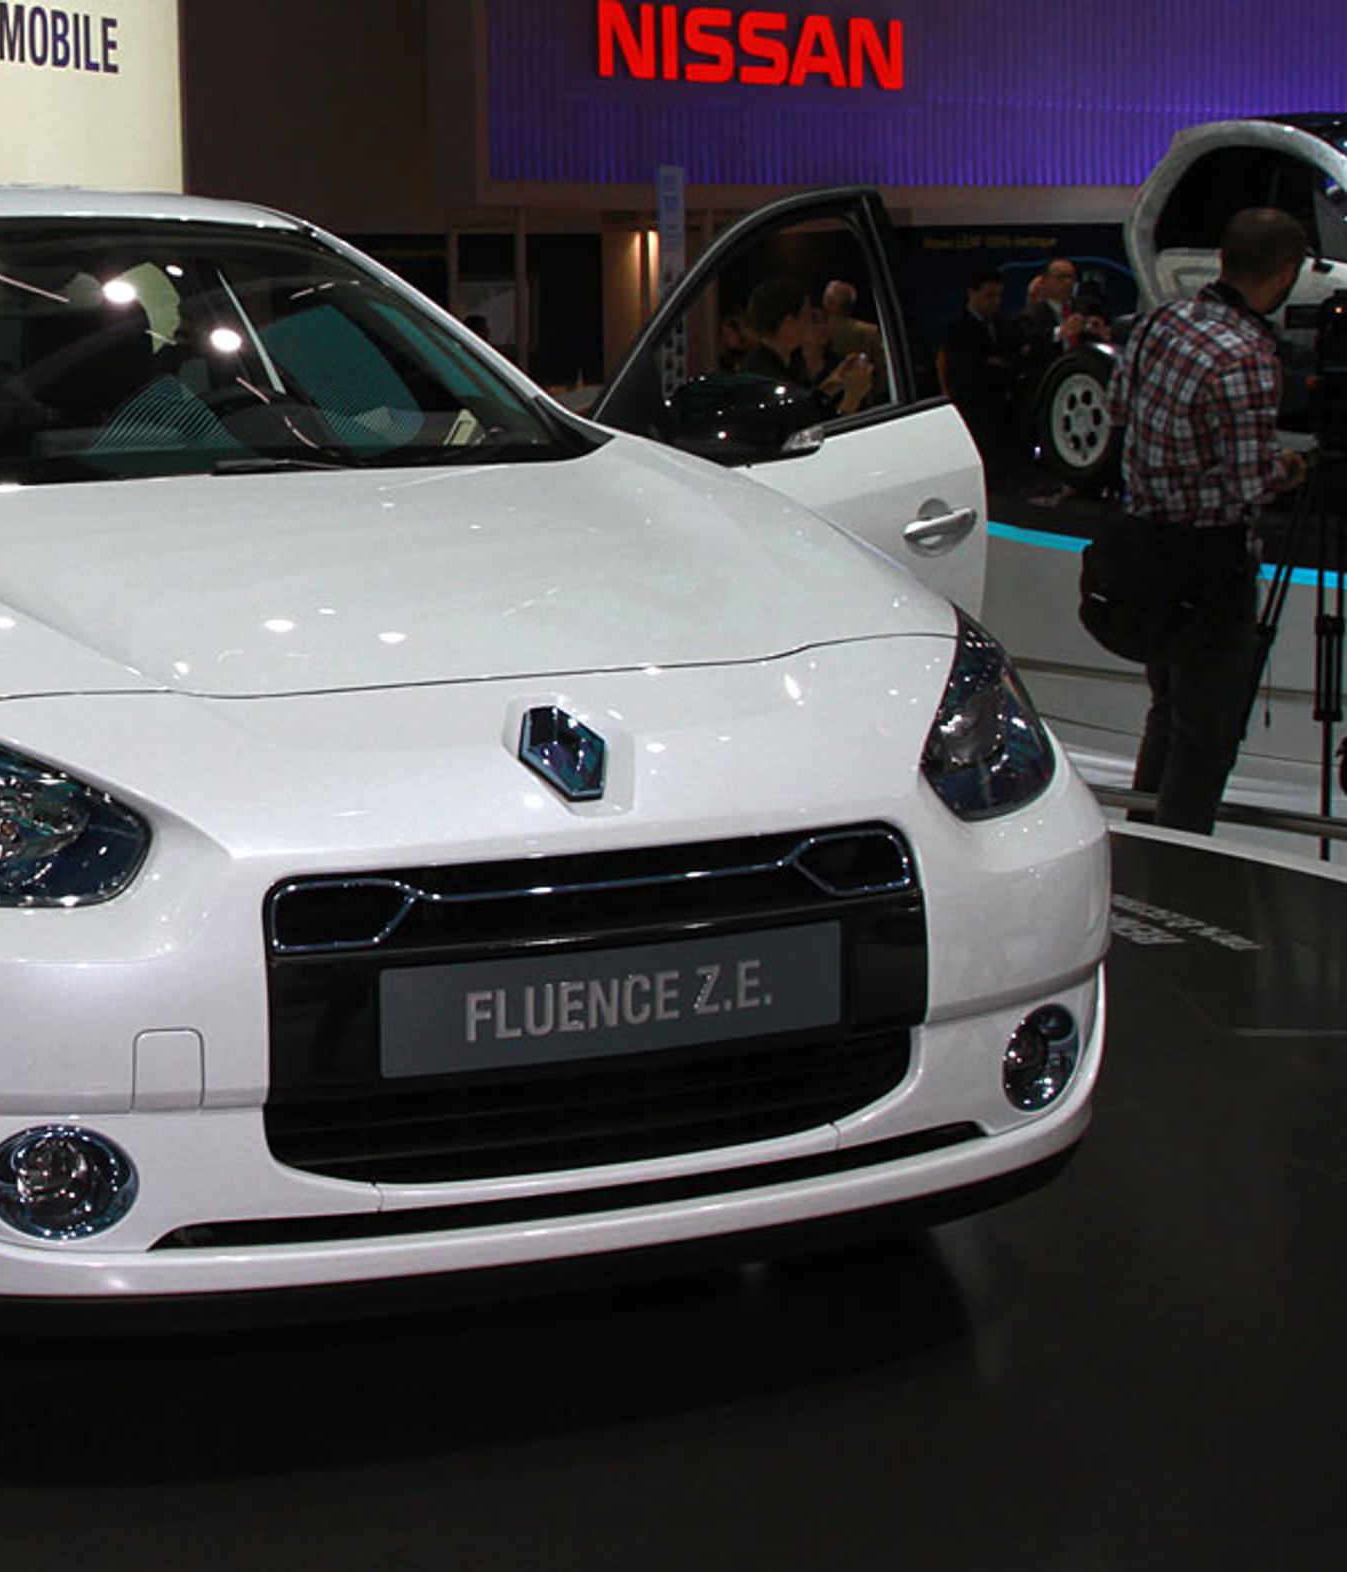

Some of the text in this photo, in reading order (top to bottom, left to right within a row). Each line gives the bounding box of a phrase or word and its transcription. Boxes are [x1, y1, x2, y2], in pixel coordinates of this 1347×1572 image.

[598, 0, 903, 90] NISSAN
[464, 958, 773, 1042] FLUENCE Z.E.
